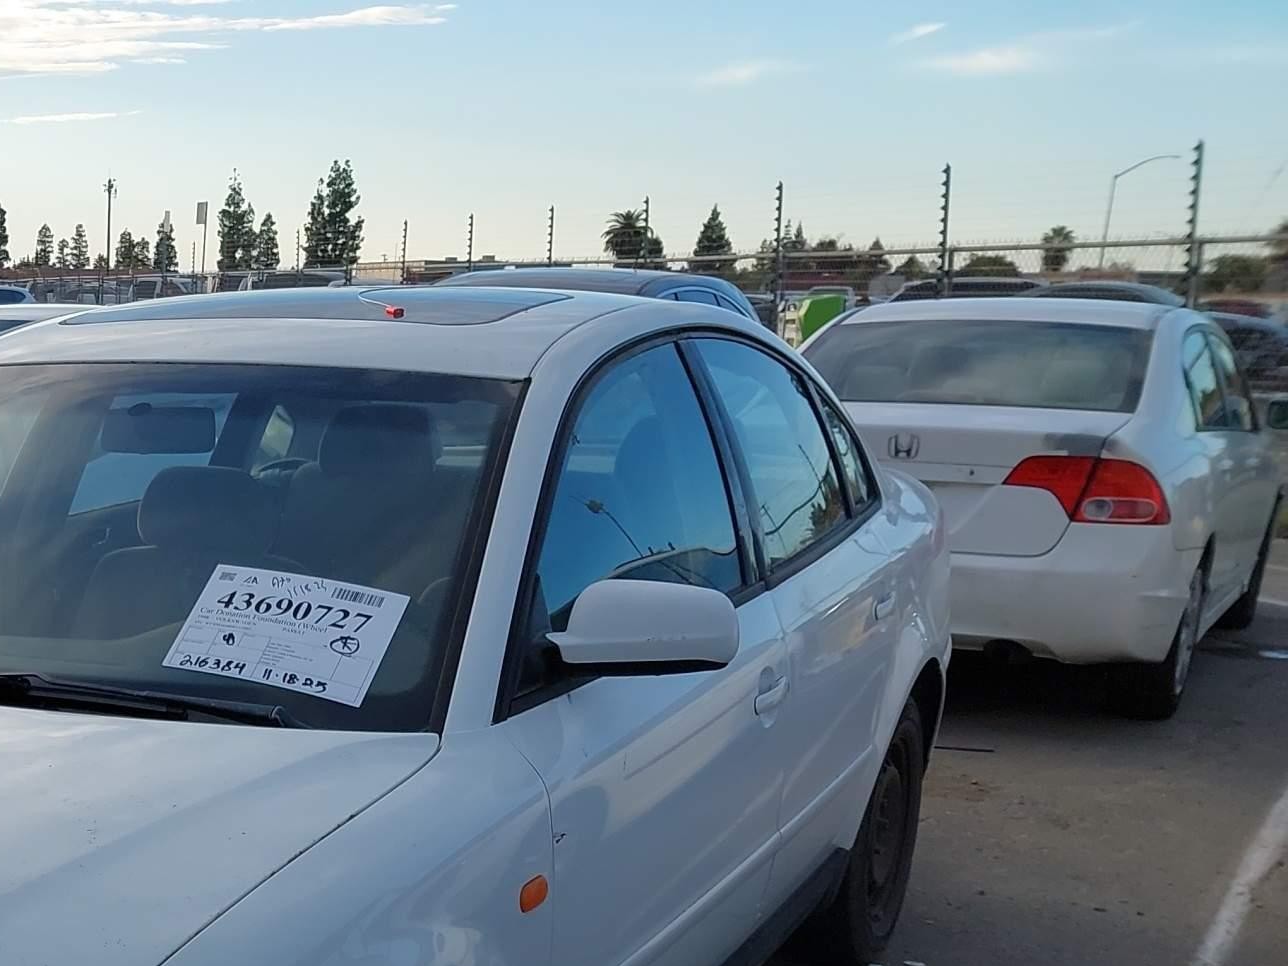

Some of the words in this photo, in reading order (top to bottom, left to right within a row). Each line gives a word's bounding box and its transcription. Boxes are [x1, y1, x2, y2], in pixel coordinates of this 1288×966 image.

[200, 607, 216, 615] Car
[215, 608, 251, 620] Donation
[252, 614, 298, 628] Foundation
[217, 590, 374, 634] 43690727
[179, 654, 247, 675] 216384
